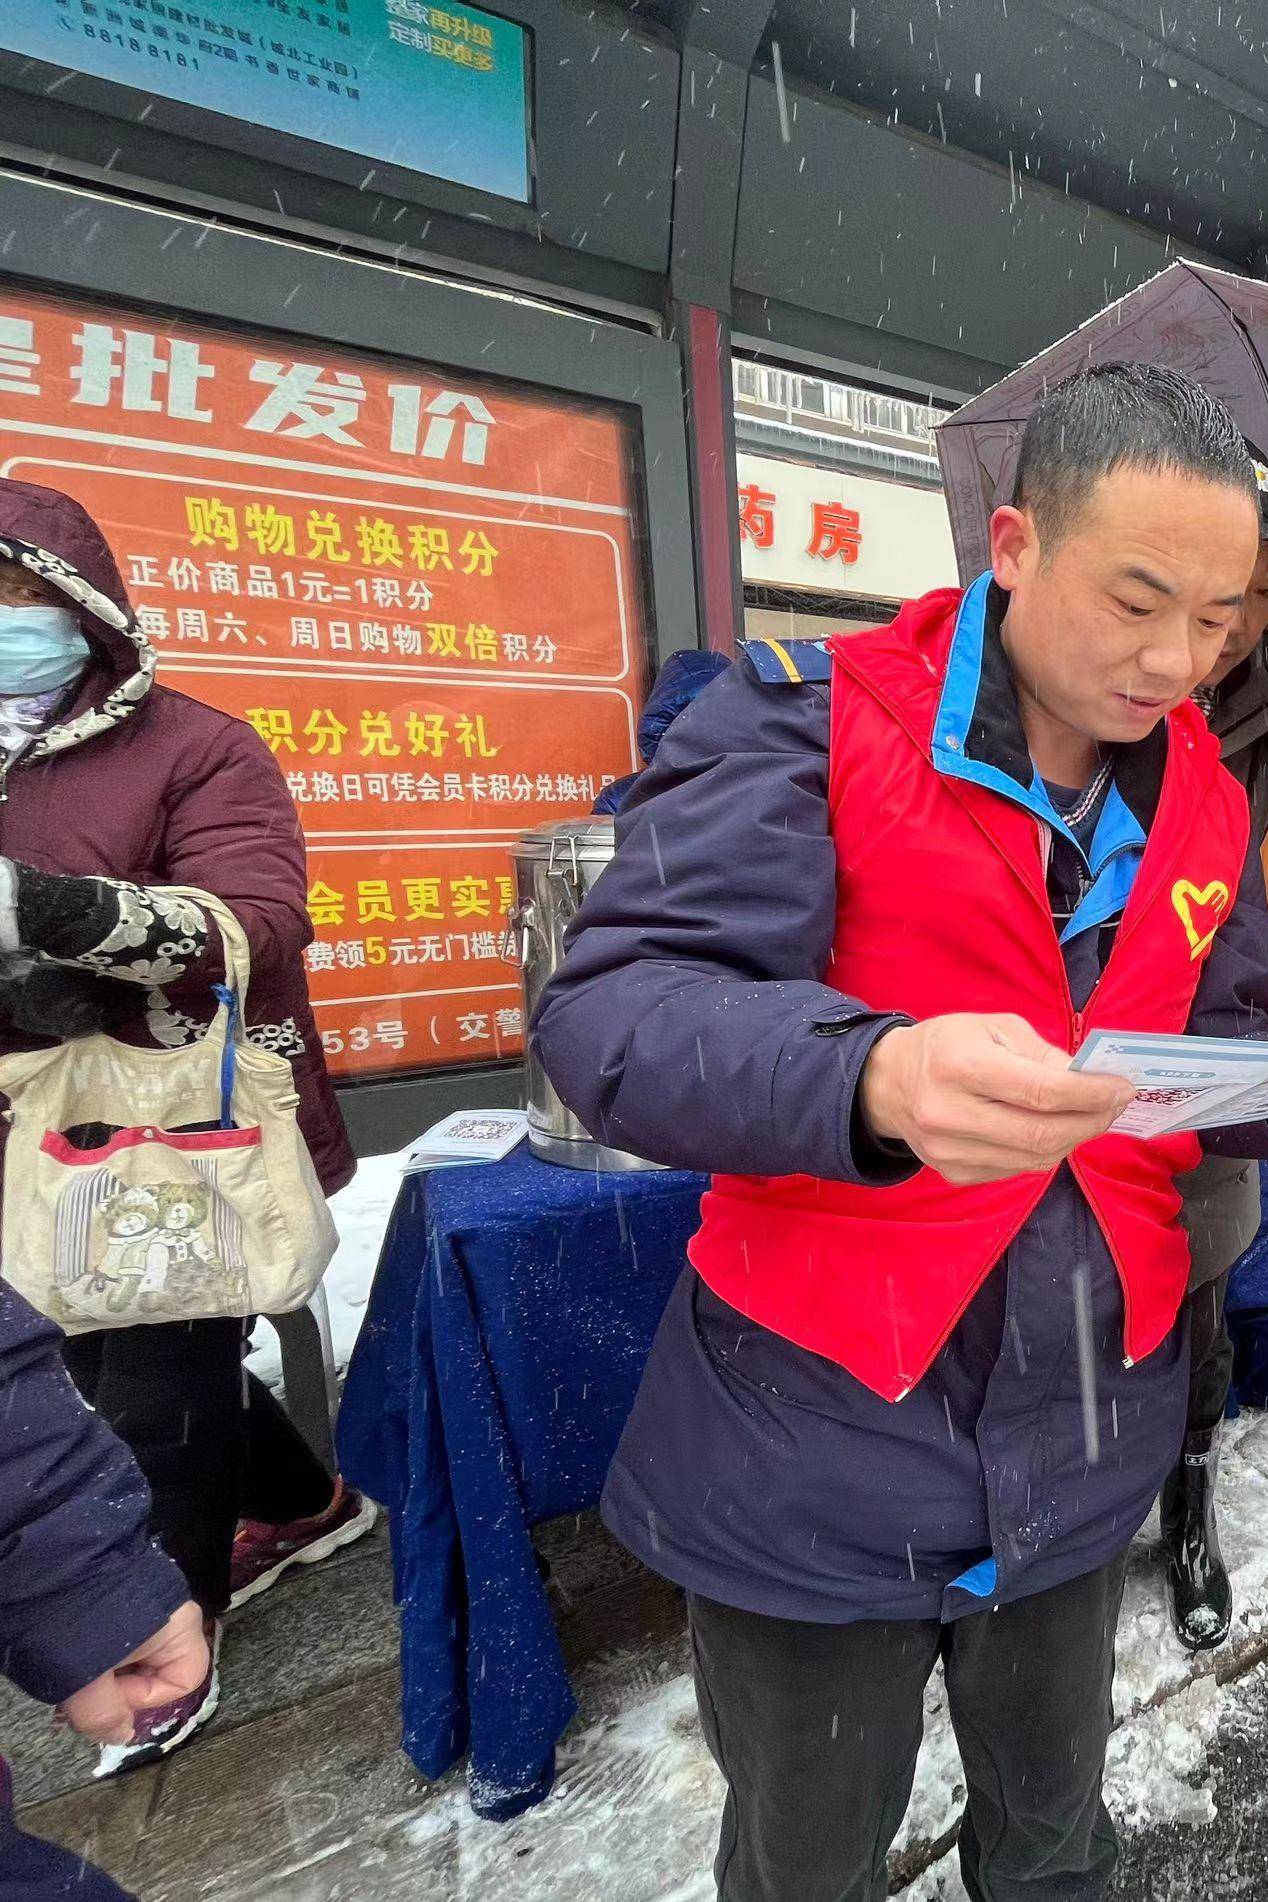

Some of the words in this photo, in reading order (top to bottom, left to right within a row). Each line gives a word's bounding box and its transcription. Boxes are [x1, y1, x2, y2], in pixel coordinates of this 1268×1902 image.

[0, 316, 497, 466] 批发价
[185, 496, 499, 577] 购物兑换积分
[737, 484, 862, 565] 药房
[127, 554, 434, 612] 正价商品1元=1积分
[135, 604, 558, 664] 每周六、周日购物双倍积分
[245, 707, 502, 758] 积分兑好礼
